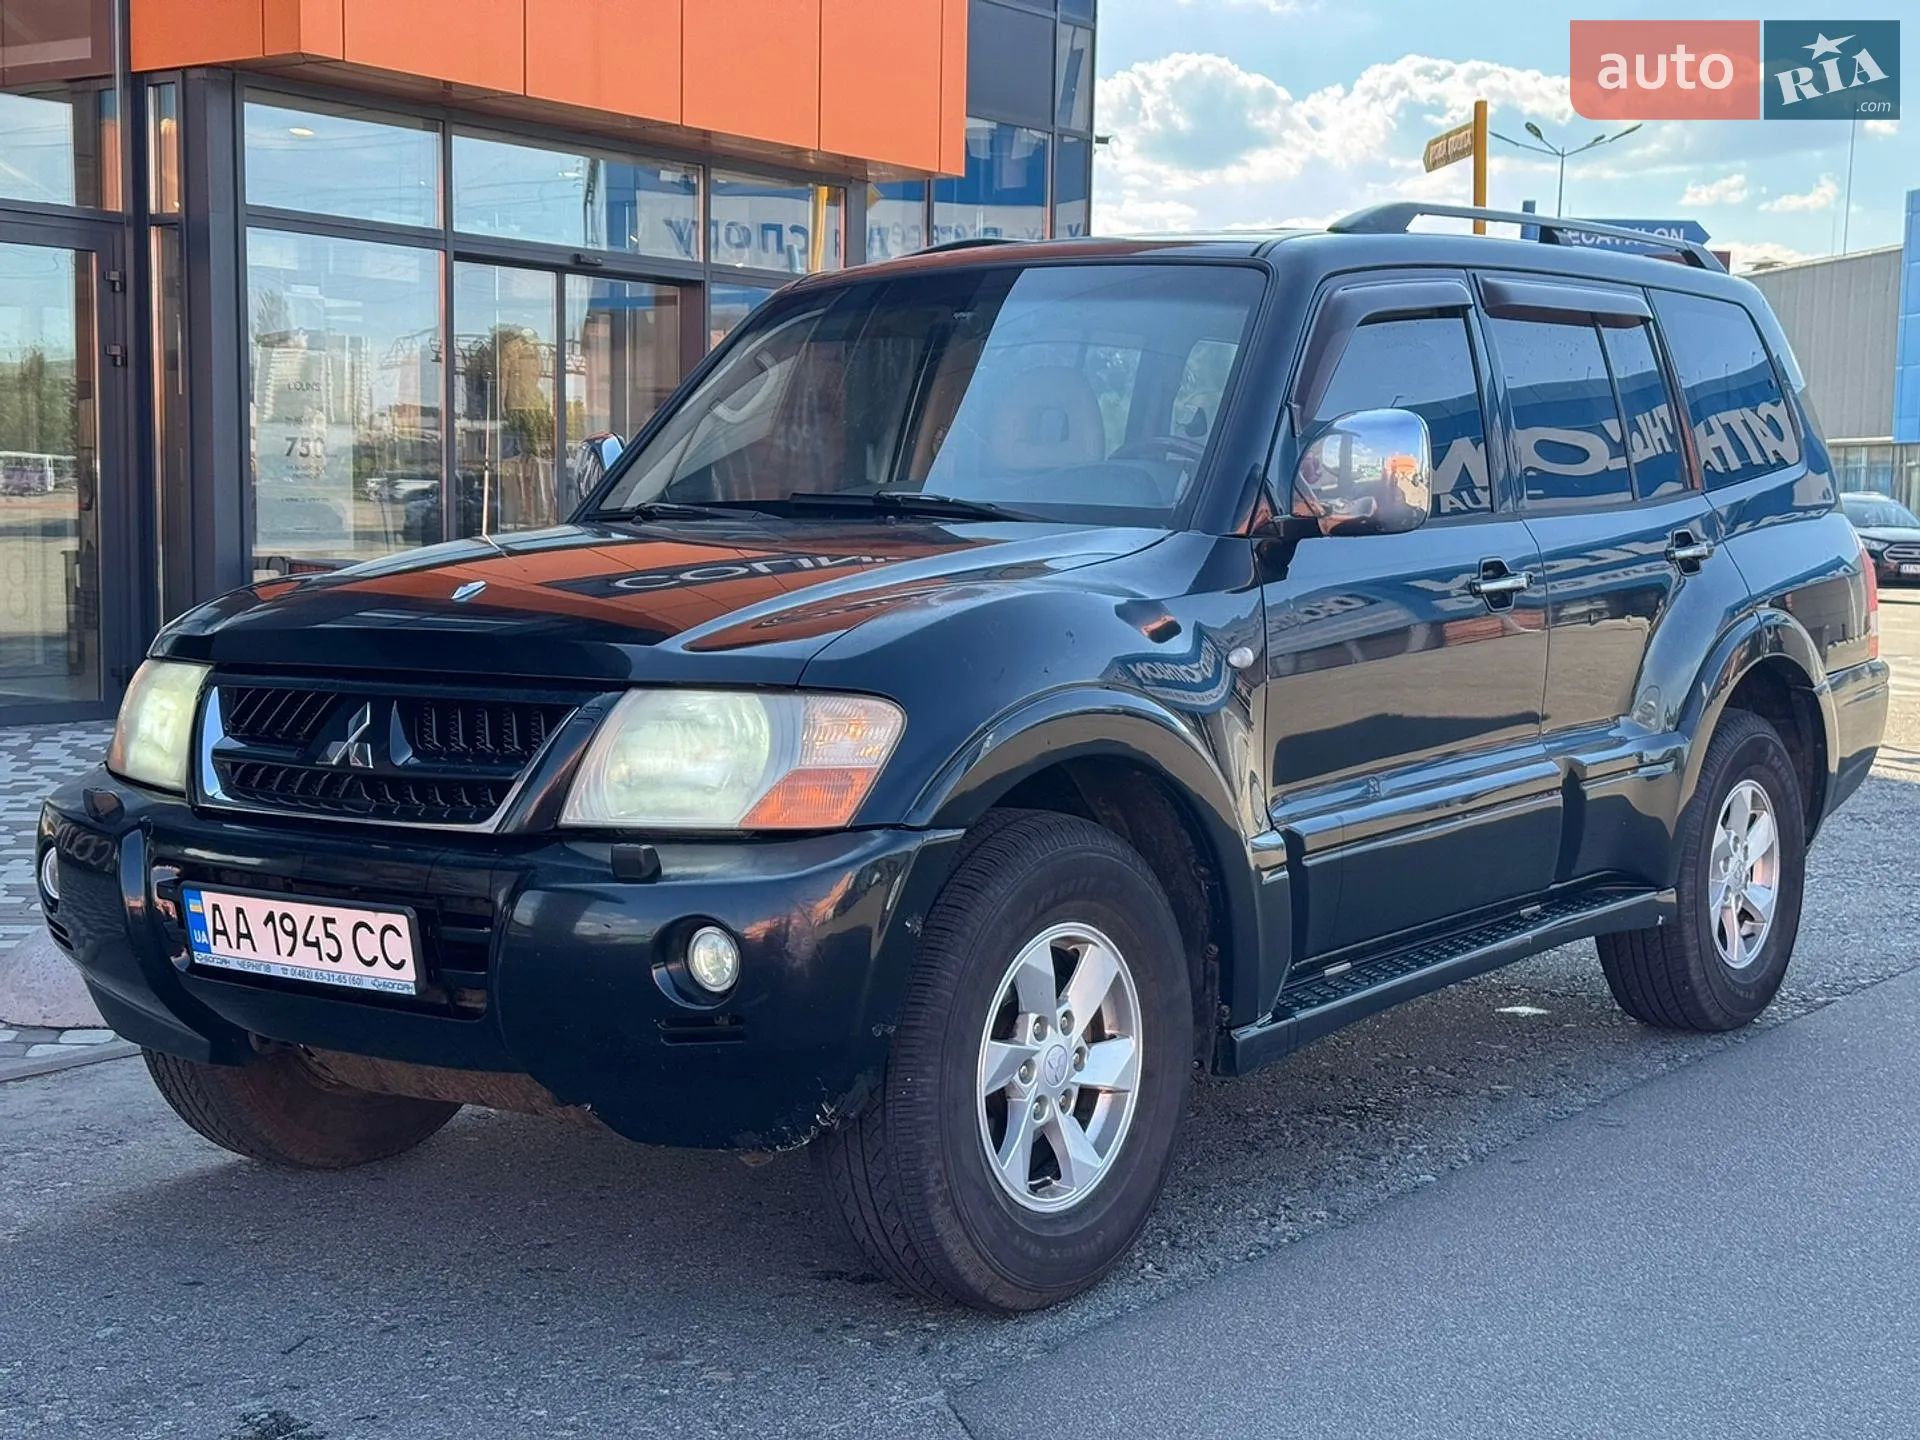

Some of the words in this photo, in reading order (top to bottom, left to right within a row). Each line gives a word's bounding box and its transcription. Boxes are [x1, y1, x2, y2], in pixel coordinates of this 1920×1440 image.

[193, 929, 209, 945] UA
[211, 903, 257, 952] AA
[262, 910, 343, 963] 1945
[352, 921, 406, 971] CC
